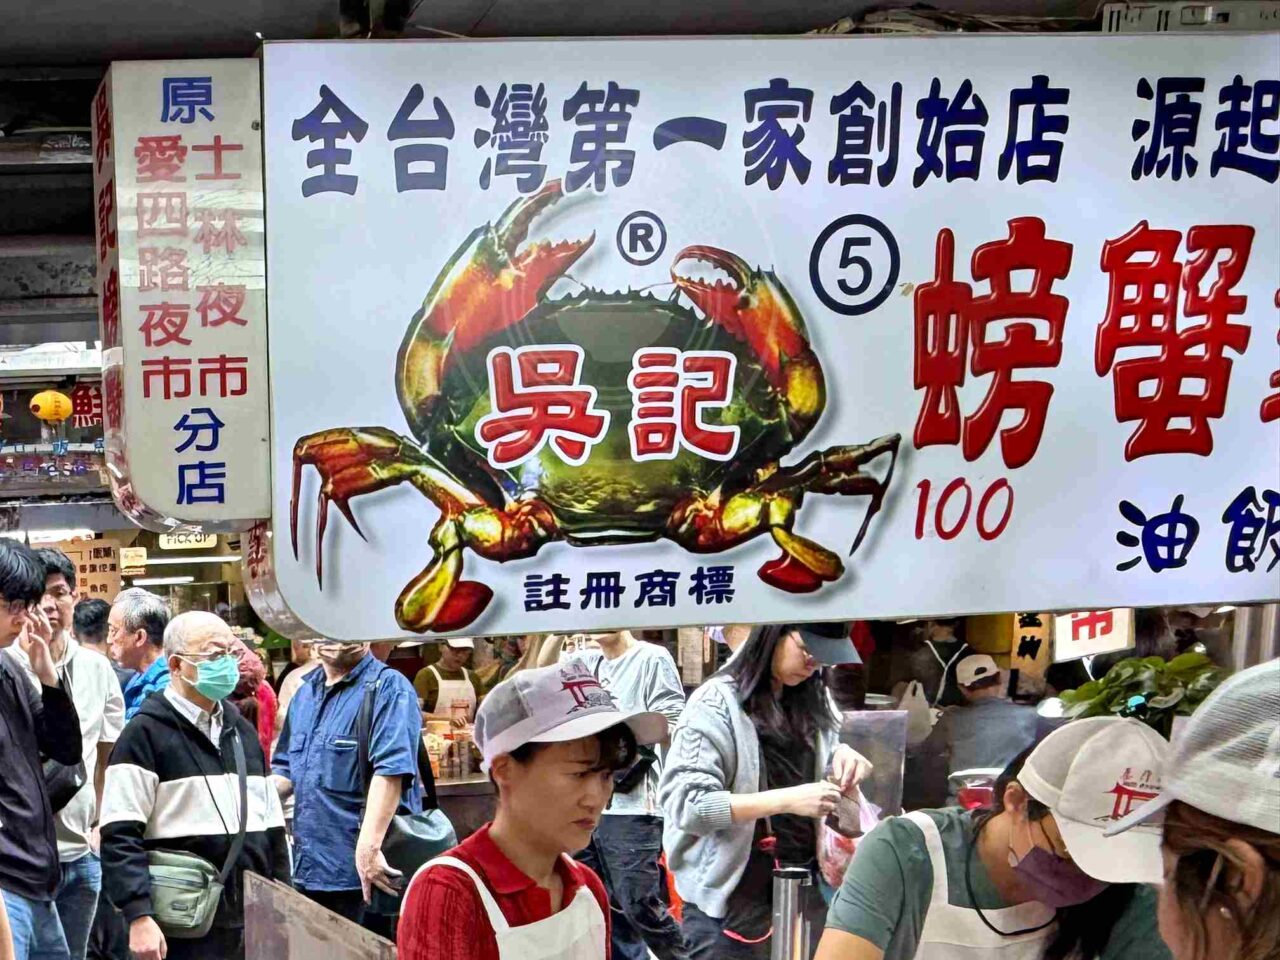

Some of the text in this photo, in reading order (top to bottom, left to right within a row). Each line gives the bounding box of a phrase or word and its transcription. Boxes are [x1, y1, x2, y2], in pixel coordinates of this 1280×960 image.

[159, 76, 215, 124] 原
[291, 74, 1280, 198] 全台灣第一家創始店 源起
[133, 134, 193, 400] 愛四路夜市
[191, 134, 249, 399] 士林夜市
[912, 216, 1280, 470] 螃蟹
[173, 407, 226, 506] 分店
[479, 348, 736, 464] 吳記
[914, 476, 1015, 542] 100
[524, 566, 735, 612] 註冊商標
